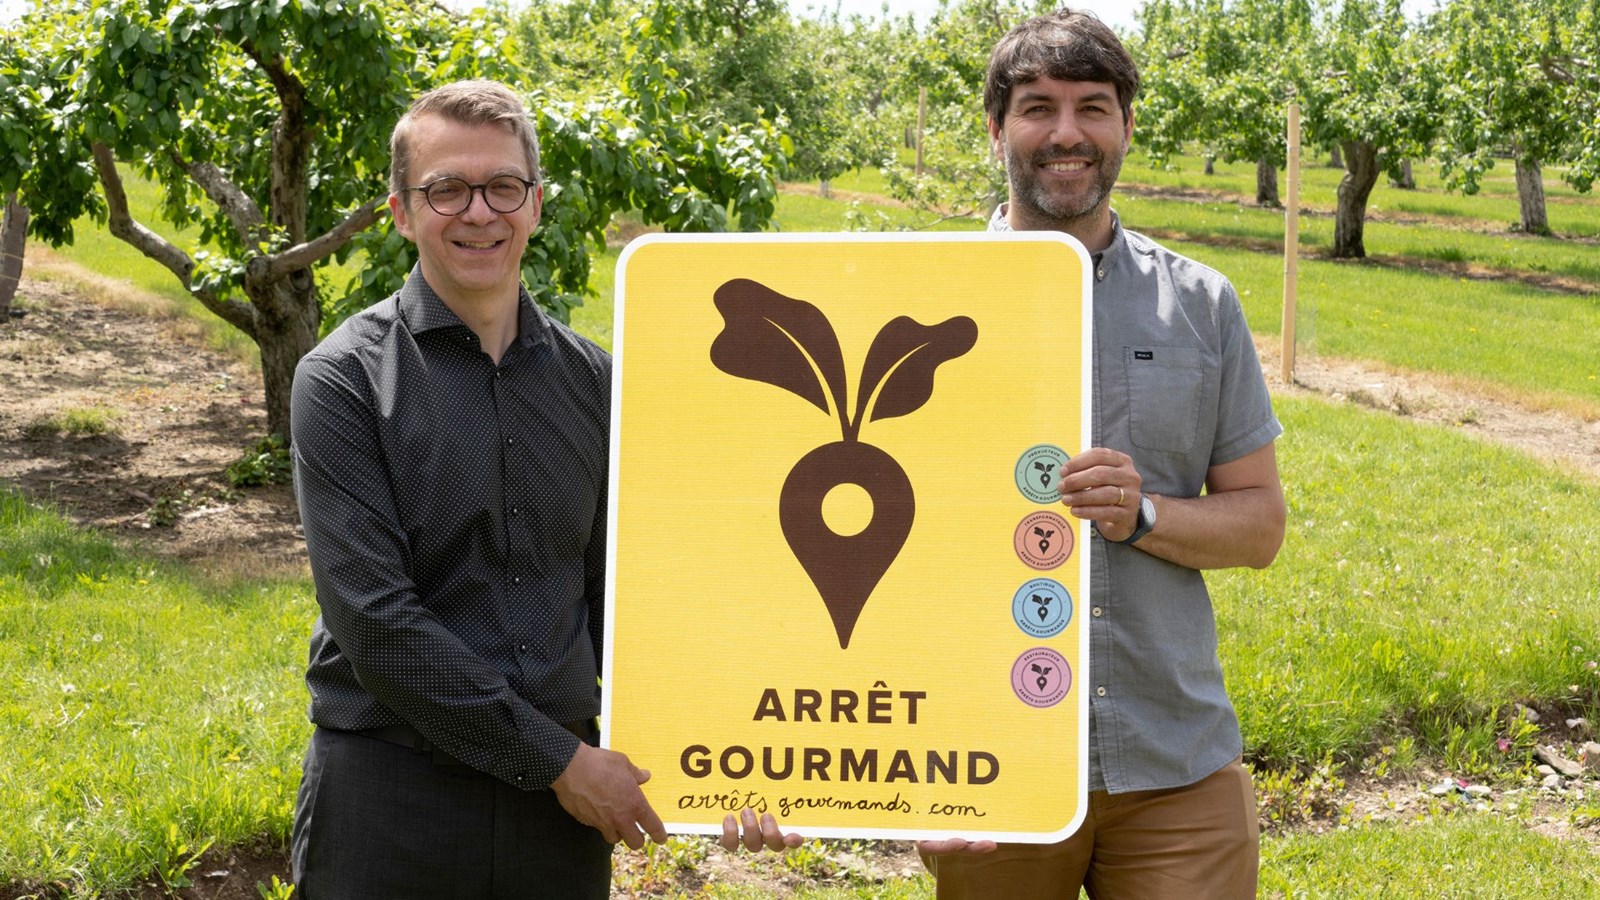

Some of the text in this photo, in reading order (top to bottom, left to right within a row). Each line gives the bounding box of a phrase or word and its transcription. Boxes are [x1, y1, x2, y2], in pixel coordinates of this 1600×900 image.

[1027, 449, 1060, 459] PRODUCTEUR
[1024, 515, 1066, 530] TRANSFORMATEUR
[1024, 651, 1060, 662] RESTAURATEUR
[753, 681, 926, 724] ARRÊT
[680, 744, 1000, 785] GOURMAND
[678, 790, 768, 813] arrêts
